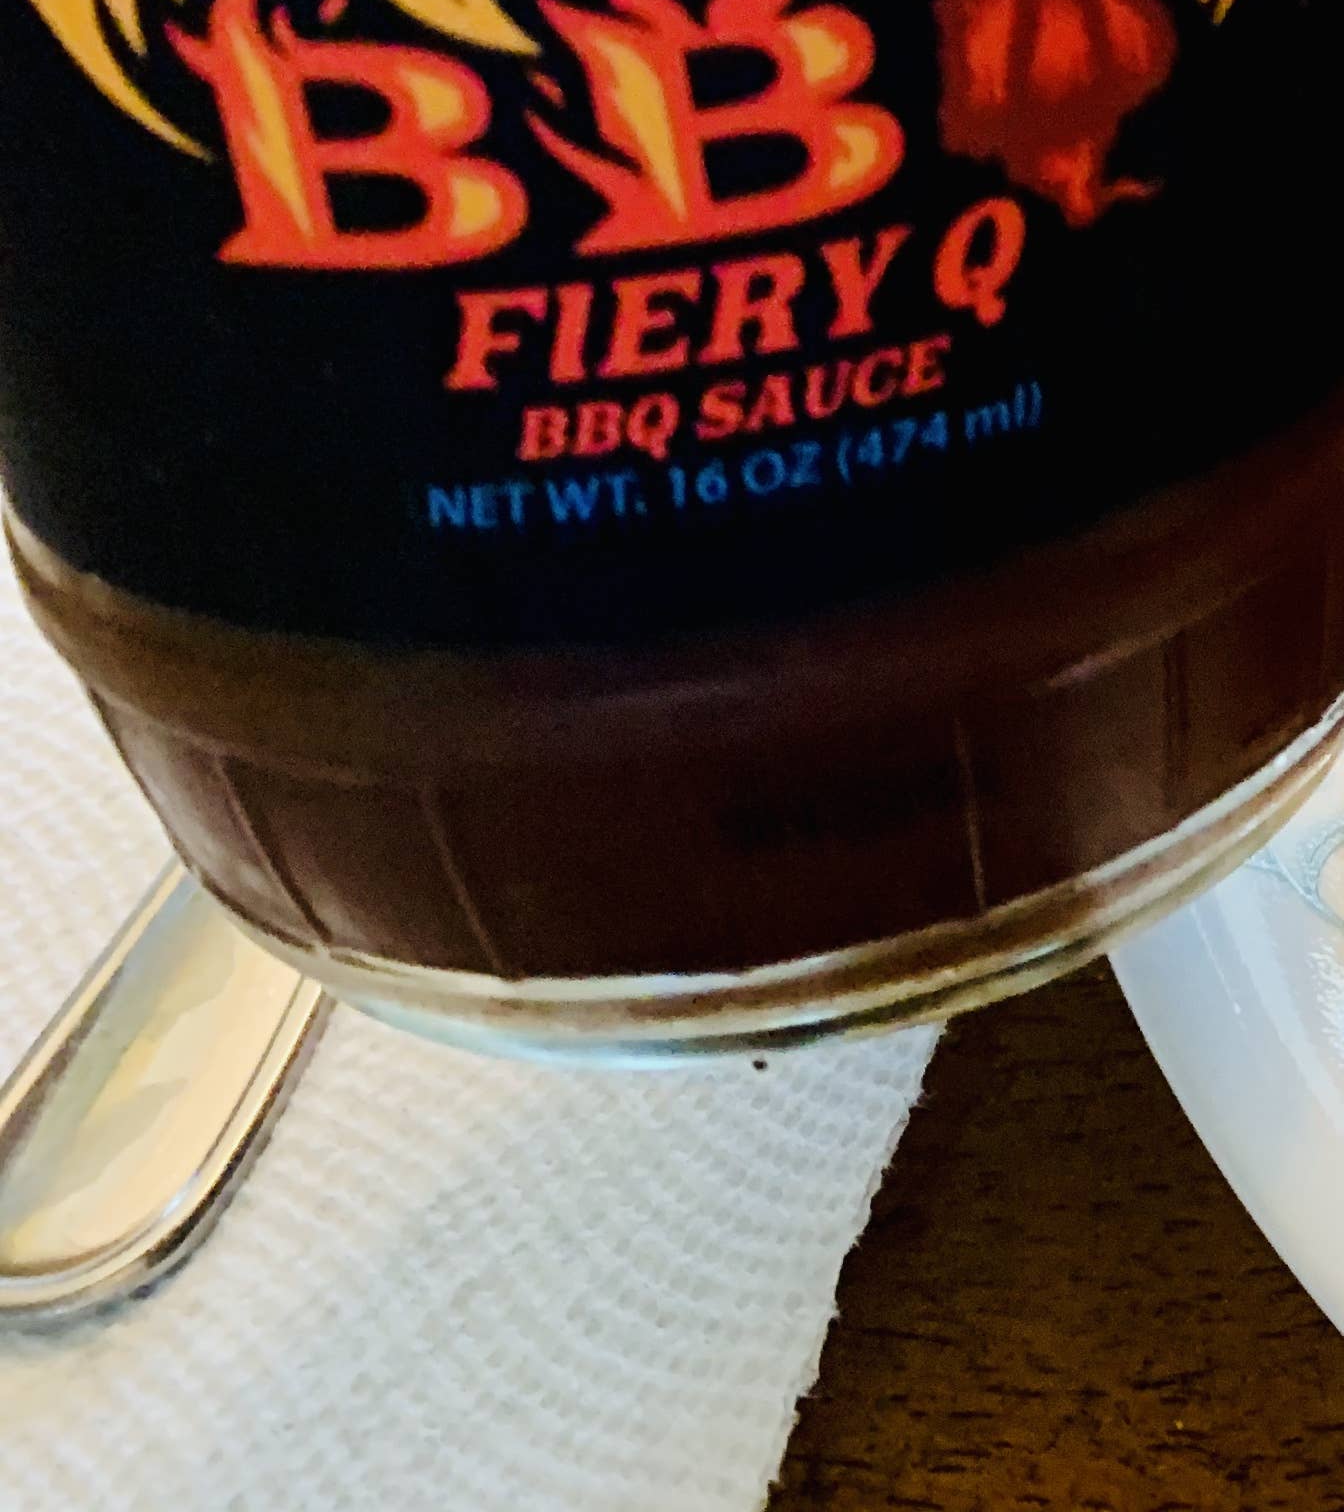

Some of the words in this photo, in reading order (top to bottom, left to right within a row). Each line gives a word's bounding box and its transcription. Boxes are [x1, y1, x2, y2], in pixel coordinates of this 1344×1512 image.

[443, 225, 911, 392] FIERY
[933, 196, 1027, 326] Q
[425, 481, 531, 529] NET
[545, 472, 649, 524] WT.
[667, 464, 728, 505] 16
[740, 442, 822, 494] OZ
[836, 412, 949, 484] (474
[963, 381, 1043, 442] ml)
[516, 392, 681, 461] BBQ
[694, 334, 951, 441] SAUCE
